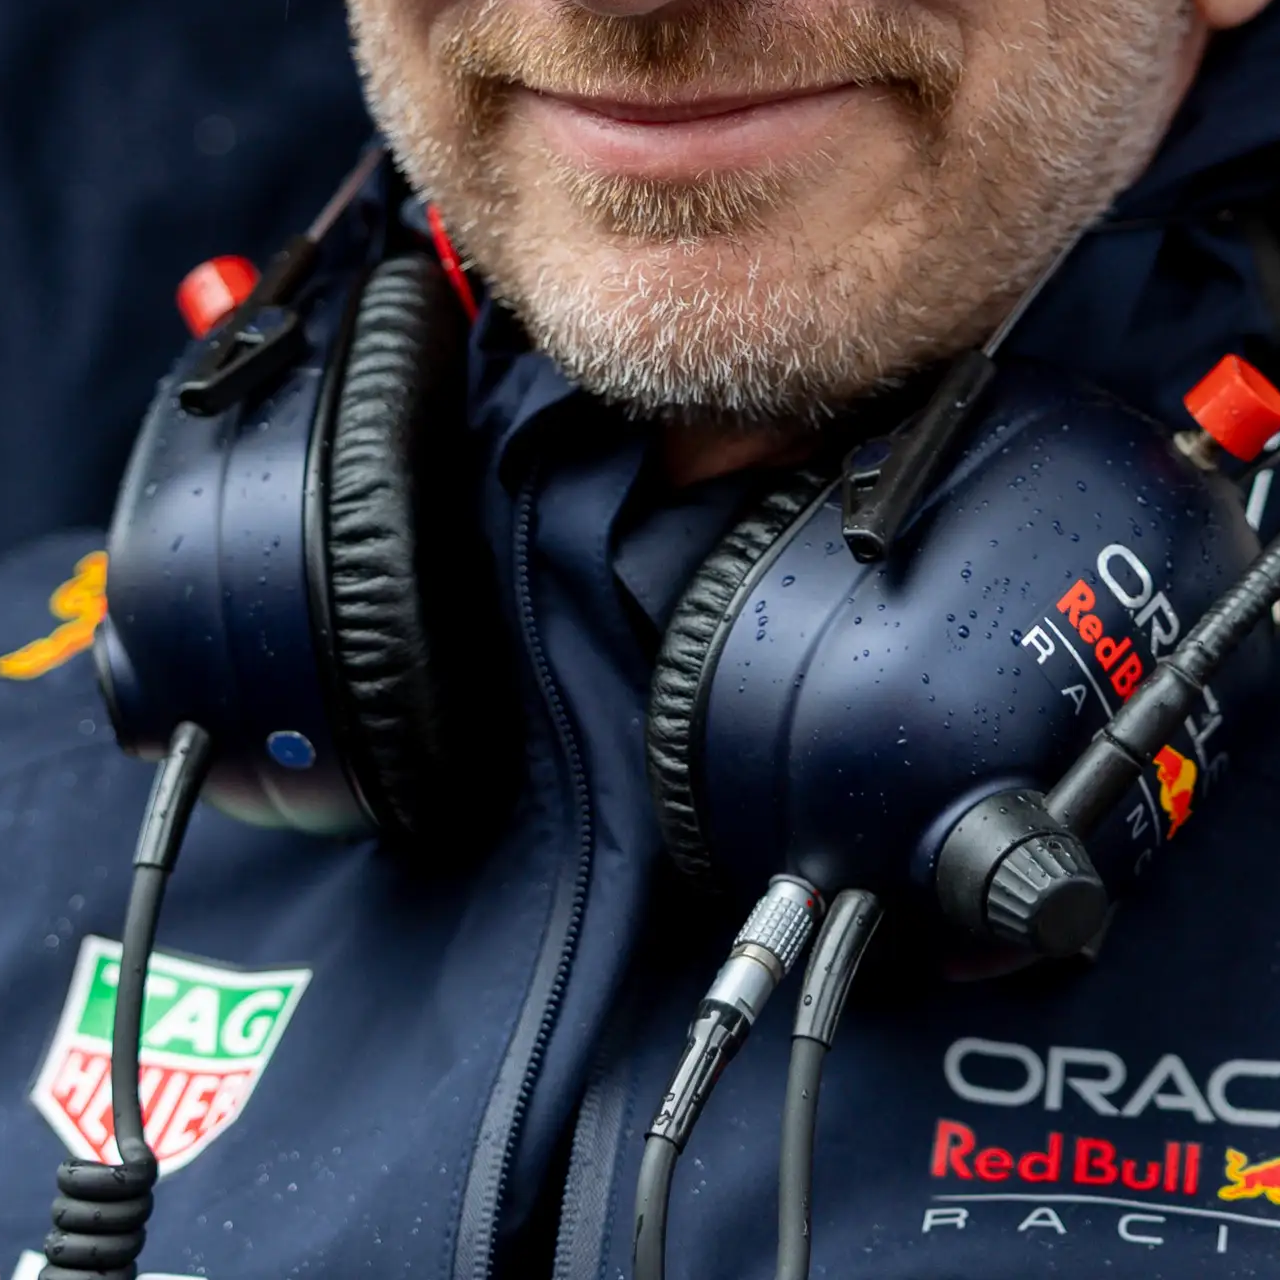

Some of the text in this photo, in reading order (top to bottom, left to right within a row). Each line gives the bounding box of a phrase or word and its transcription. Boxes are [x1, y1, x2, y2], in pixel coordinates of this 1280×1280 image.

[1056, 579, 1132, 672] Red
[930, 1119, 1201, 1194] Red Bull
